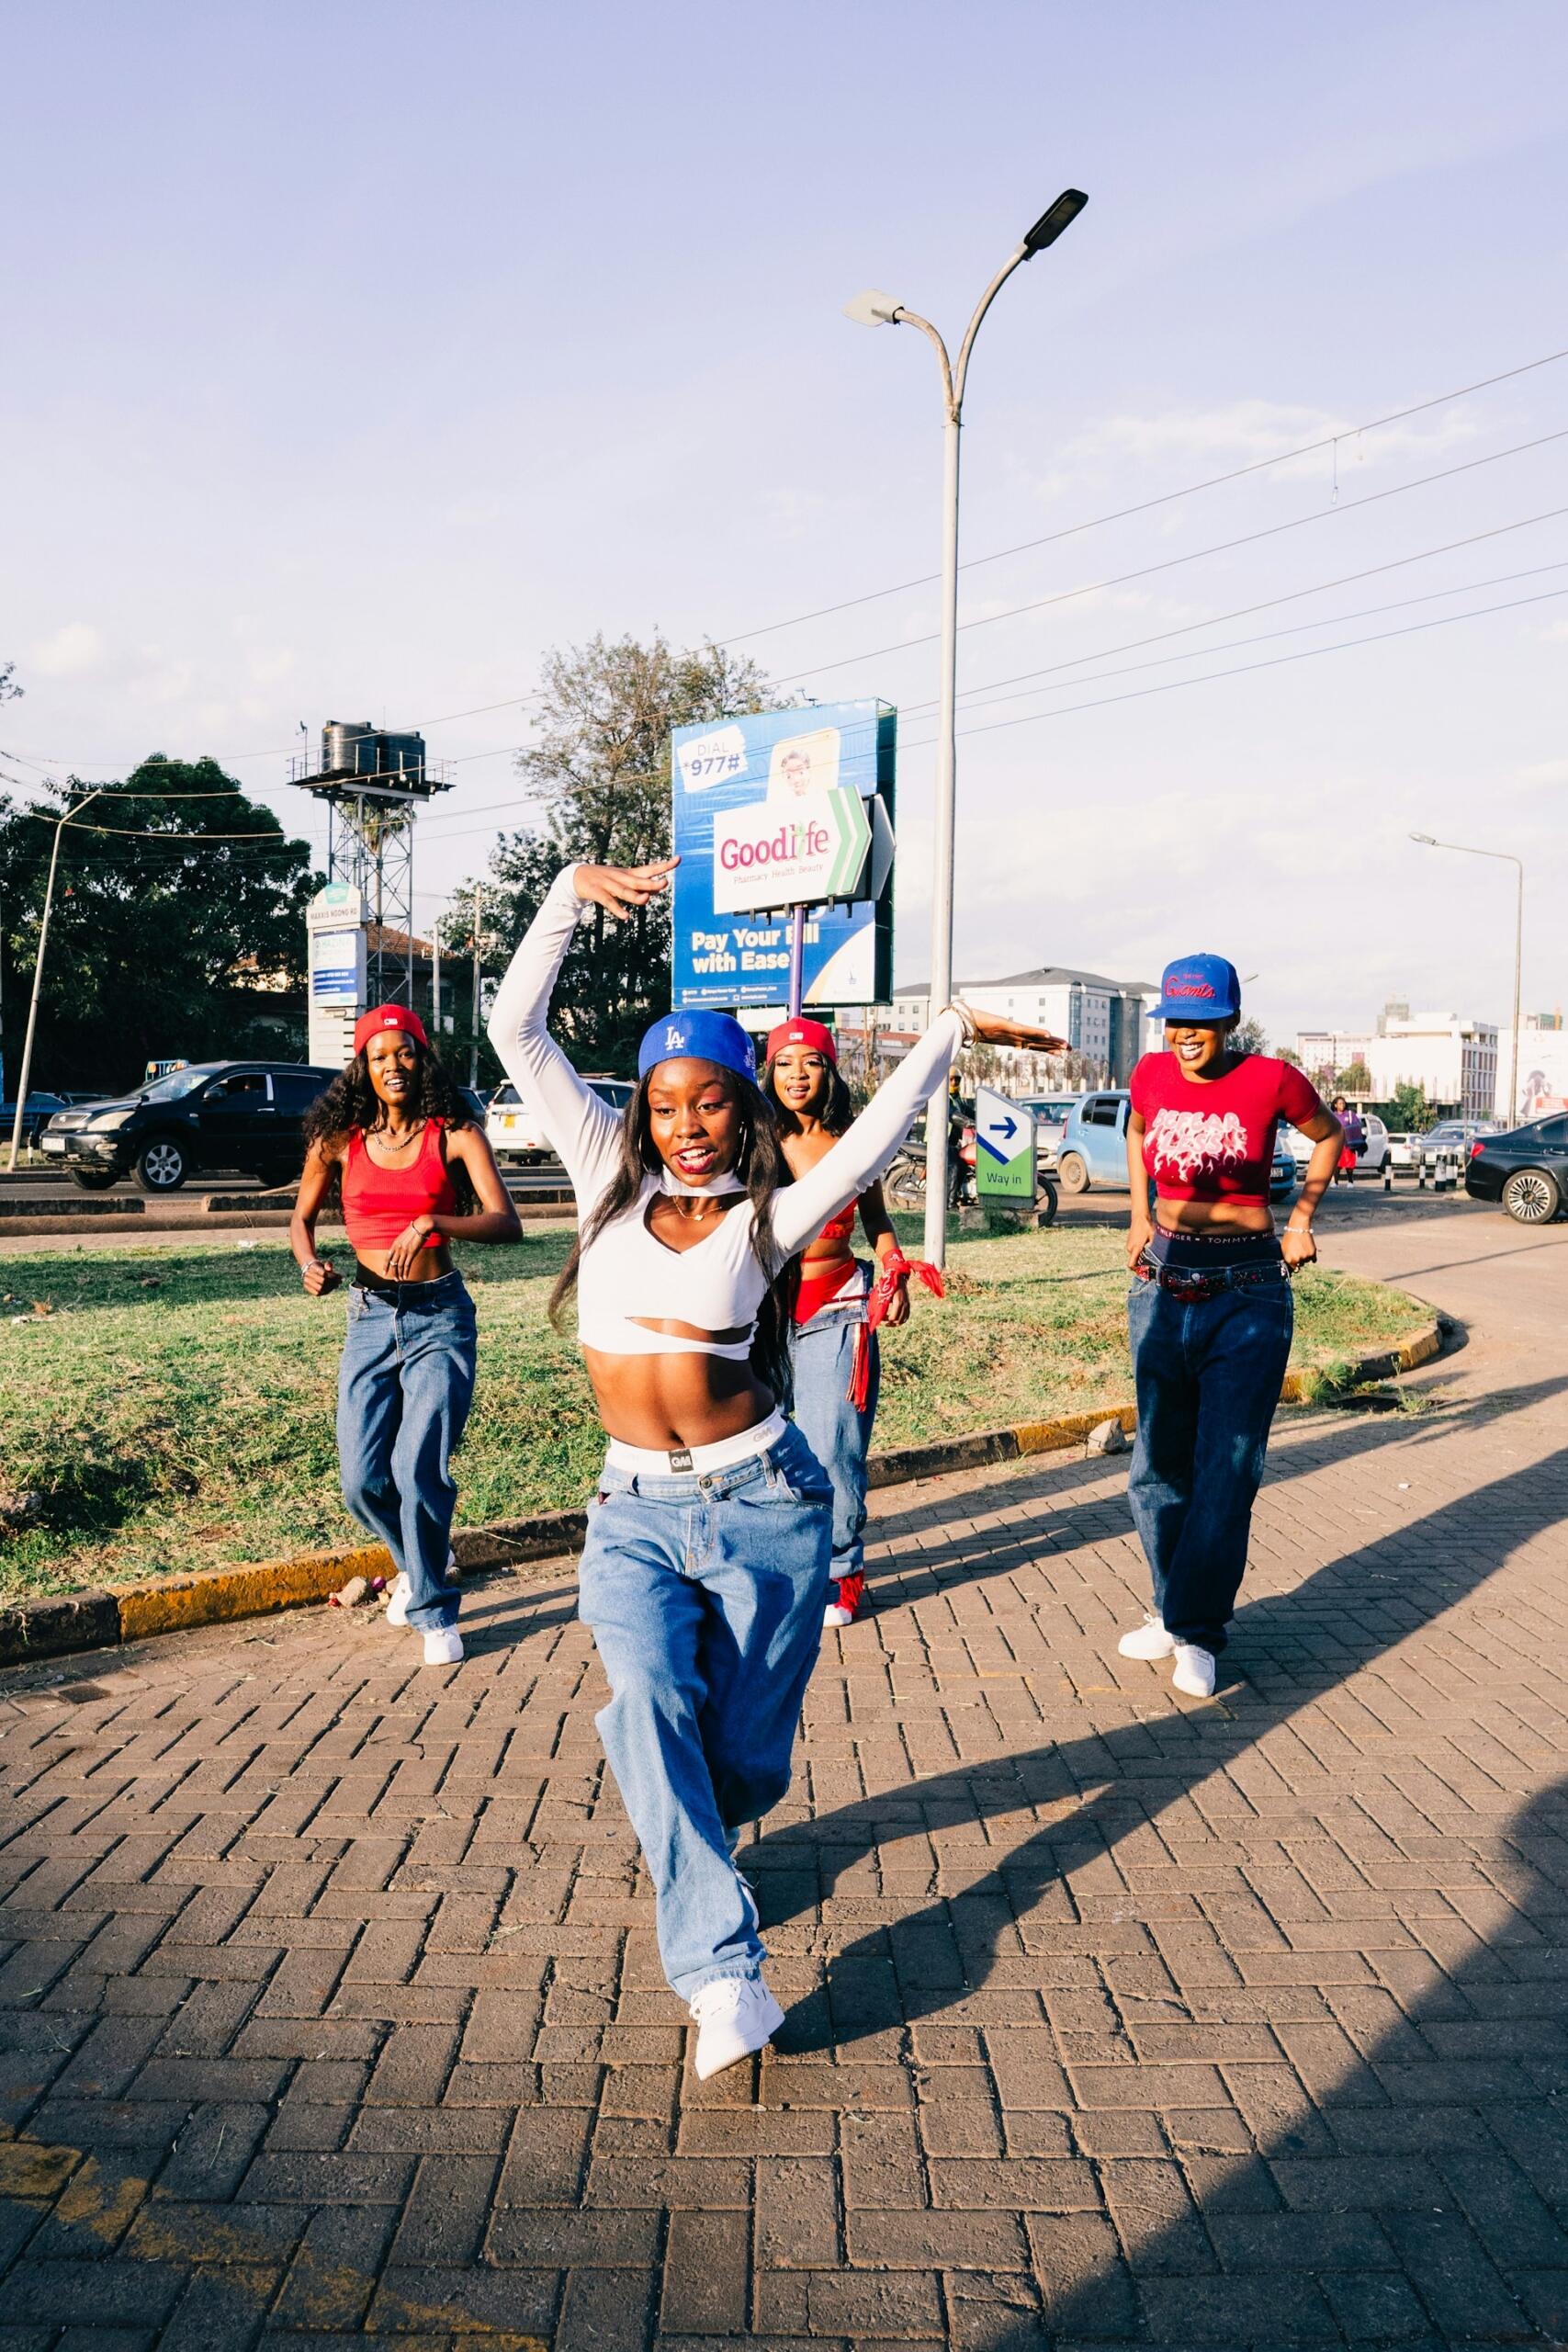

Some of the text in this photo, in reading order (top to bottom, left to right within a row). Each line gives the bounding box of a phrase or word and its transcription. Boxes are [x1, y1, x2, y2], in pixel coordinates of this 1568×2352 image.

[697, 742, 730, 757] DIAL
[720, 820, 829, 871] Goodlife
[692, 931, 729, 953] Pay
[732, 928, 781, 948] Your
[693, 950, 737, 974] with
[665, 1025, 685, 1051] LA
[987, 1172, 1021, 1186] Way in
[1159, 1227, 1247, 1244] HILFIGER TOMMY
